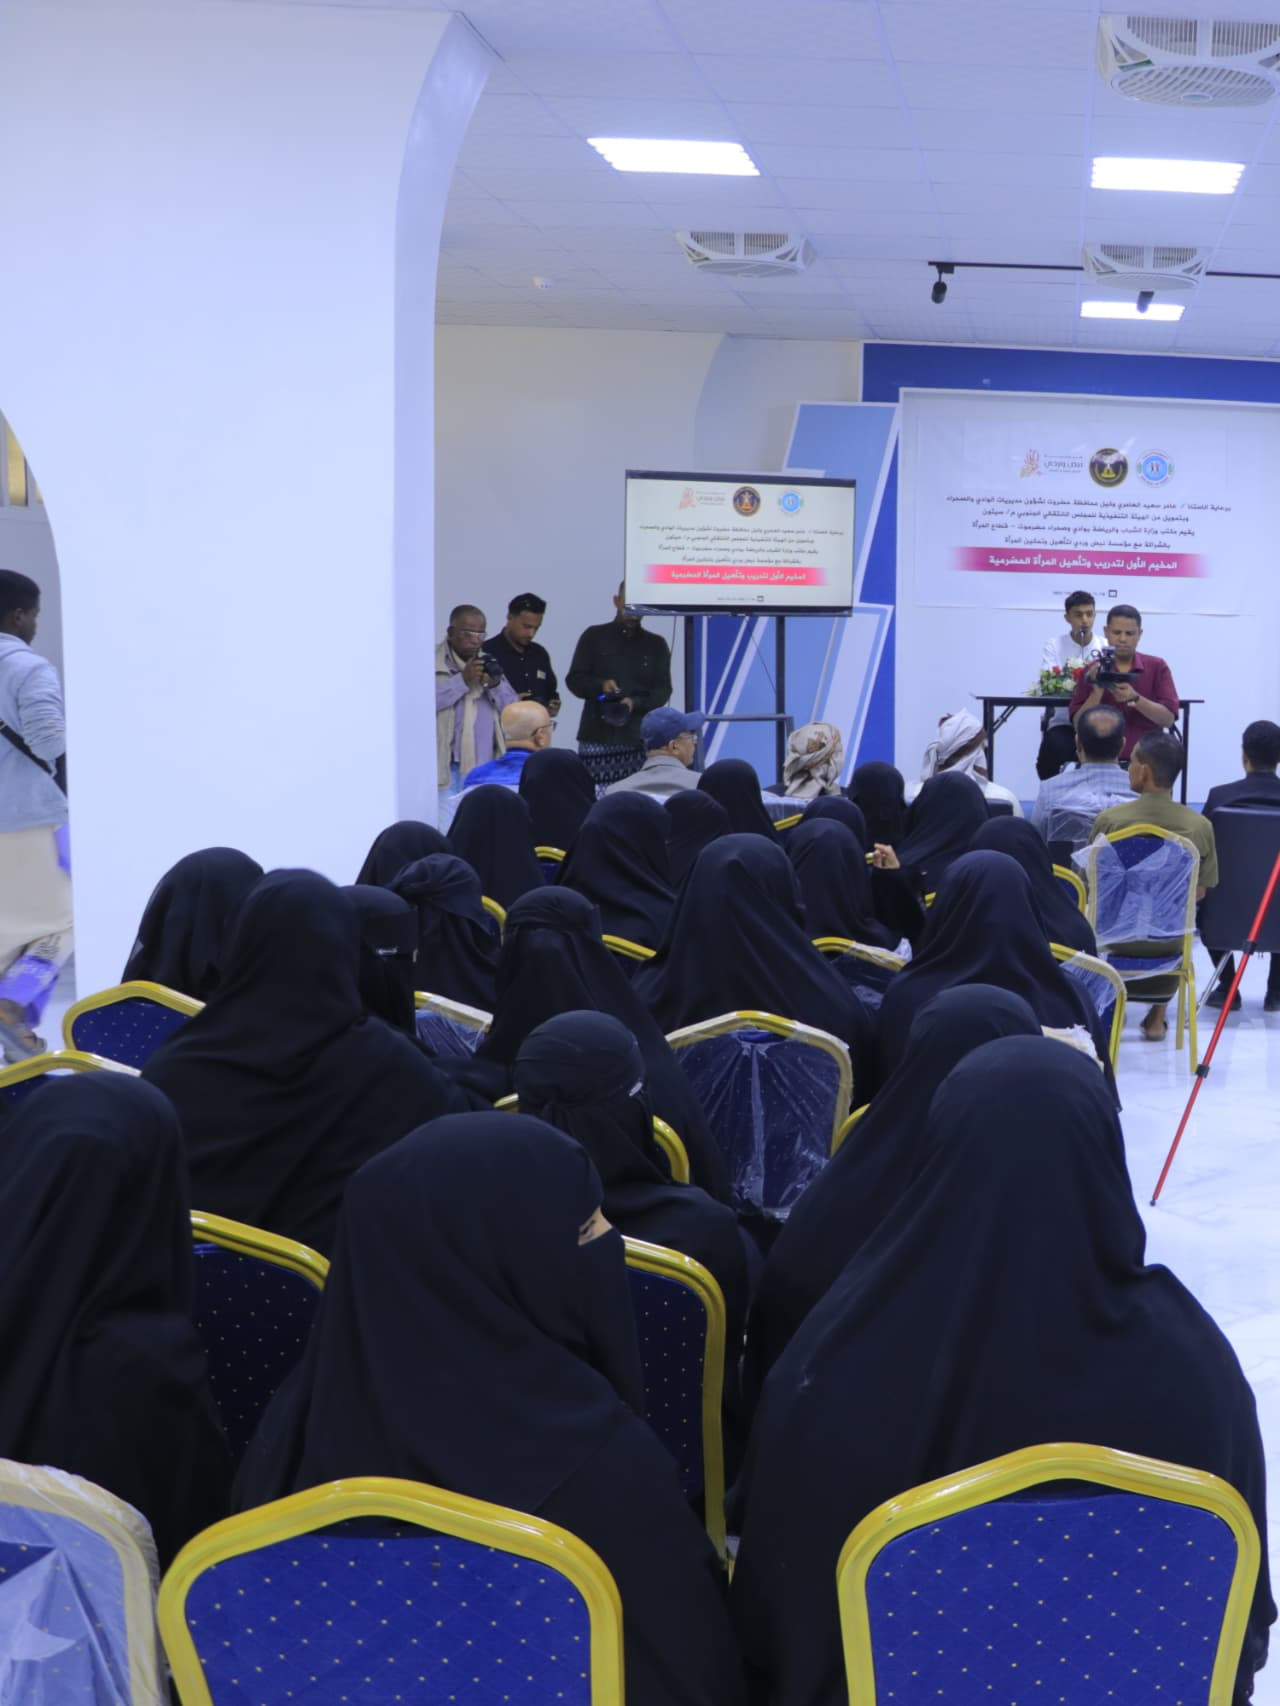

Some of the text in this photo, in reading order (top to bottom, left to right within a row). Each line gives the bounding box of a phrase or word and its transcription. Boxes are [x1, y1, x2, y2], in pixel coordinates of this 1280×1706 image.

[988, 554, 1178, 573] المخيم الأول لتدريب وتأهيل المرأة الحضرمية
